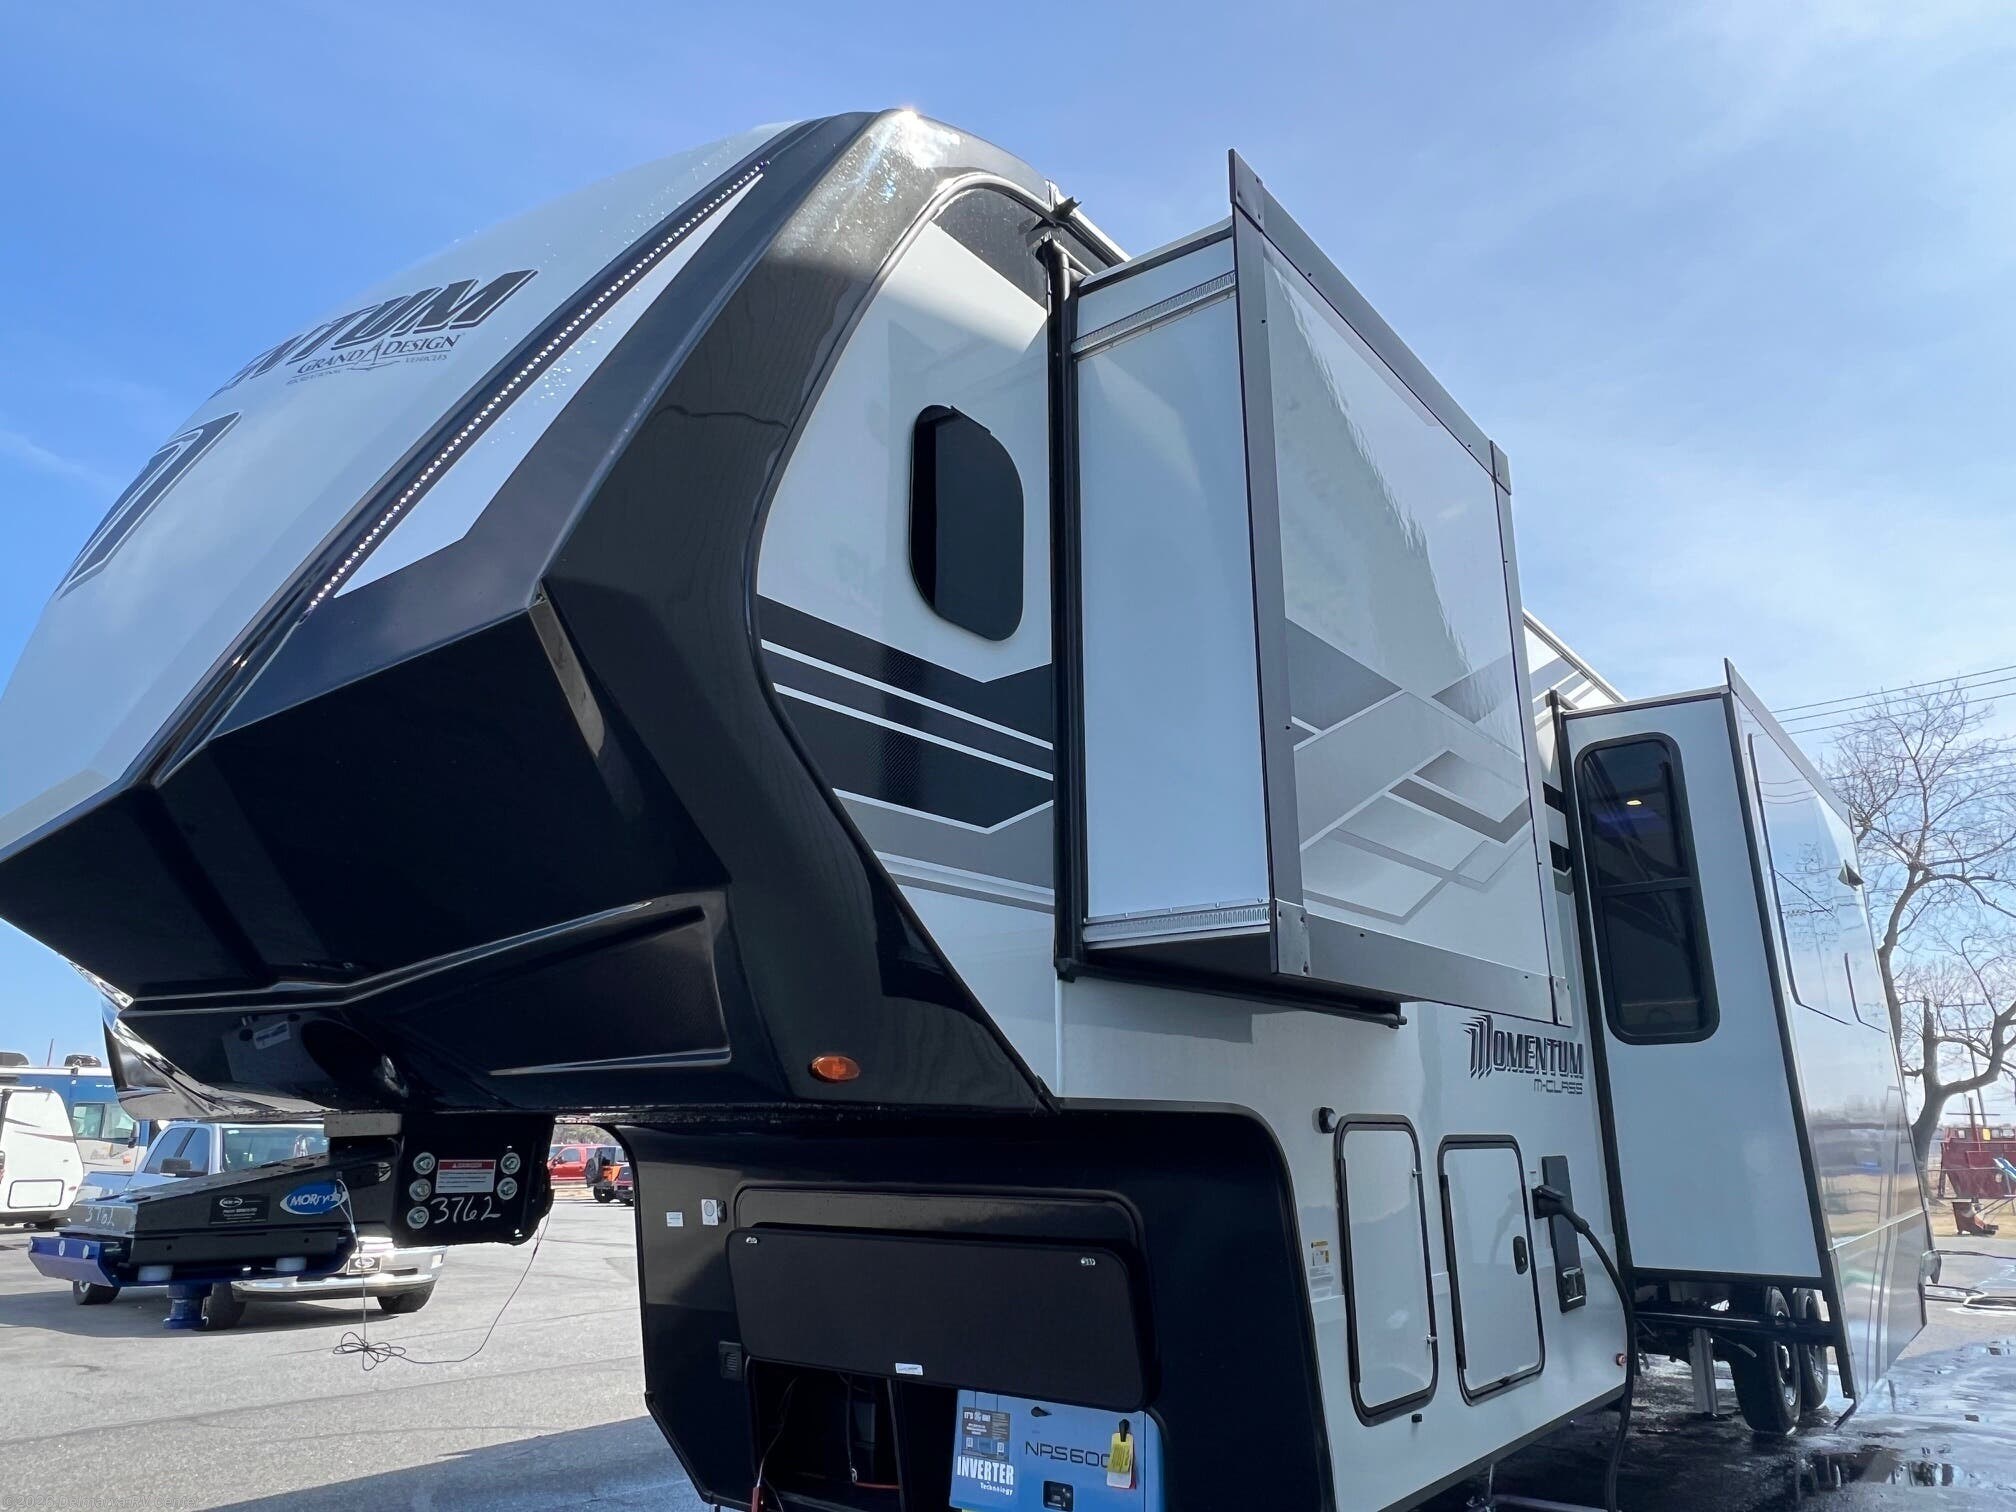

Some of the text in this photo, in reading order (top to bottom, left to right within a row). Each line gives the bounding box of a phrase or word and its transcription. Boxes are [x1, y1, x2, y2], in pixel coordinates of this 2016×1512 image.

[298, 334, 461, 374] GRAND DESIGN
[1462, 1015, 1584, 1080] MOMENTUM
[430, 1195, 501, 1224] 3762
[957, 1455, 1014, 1486] INVERTER
